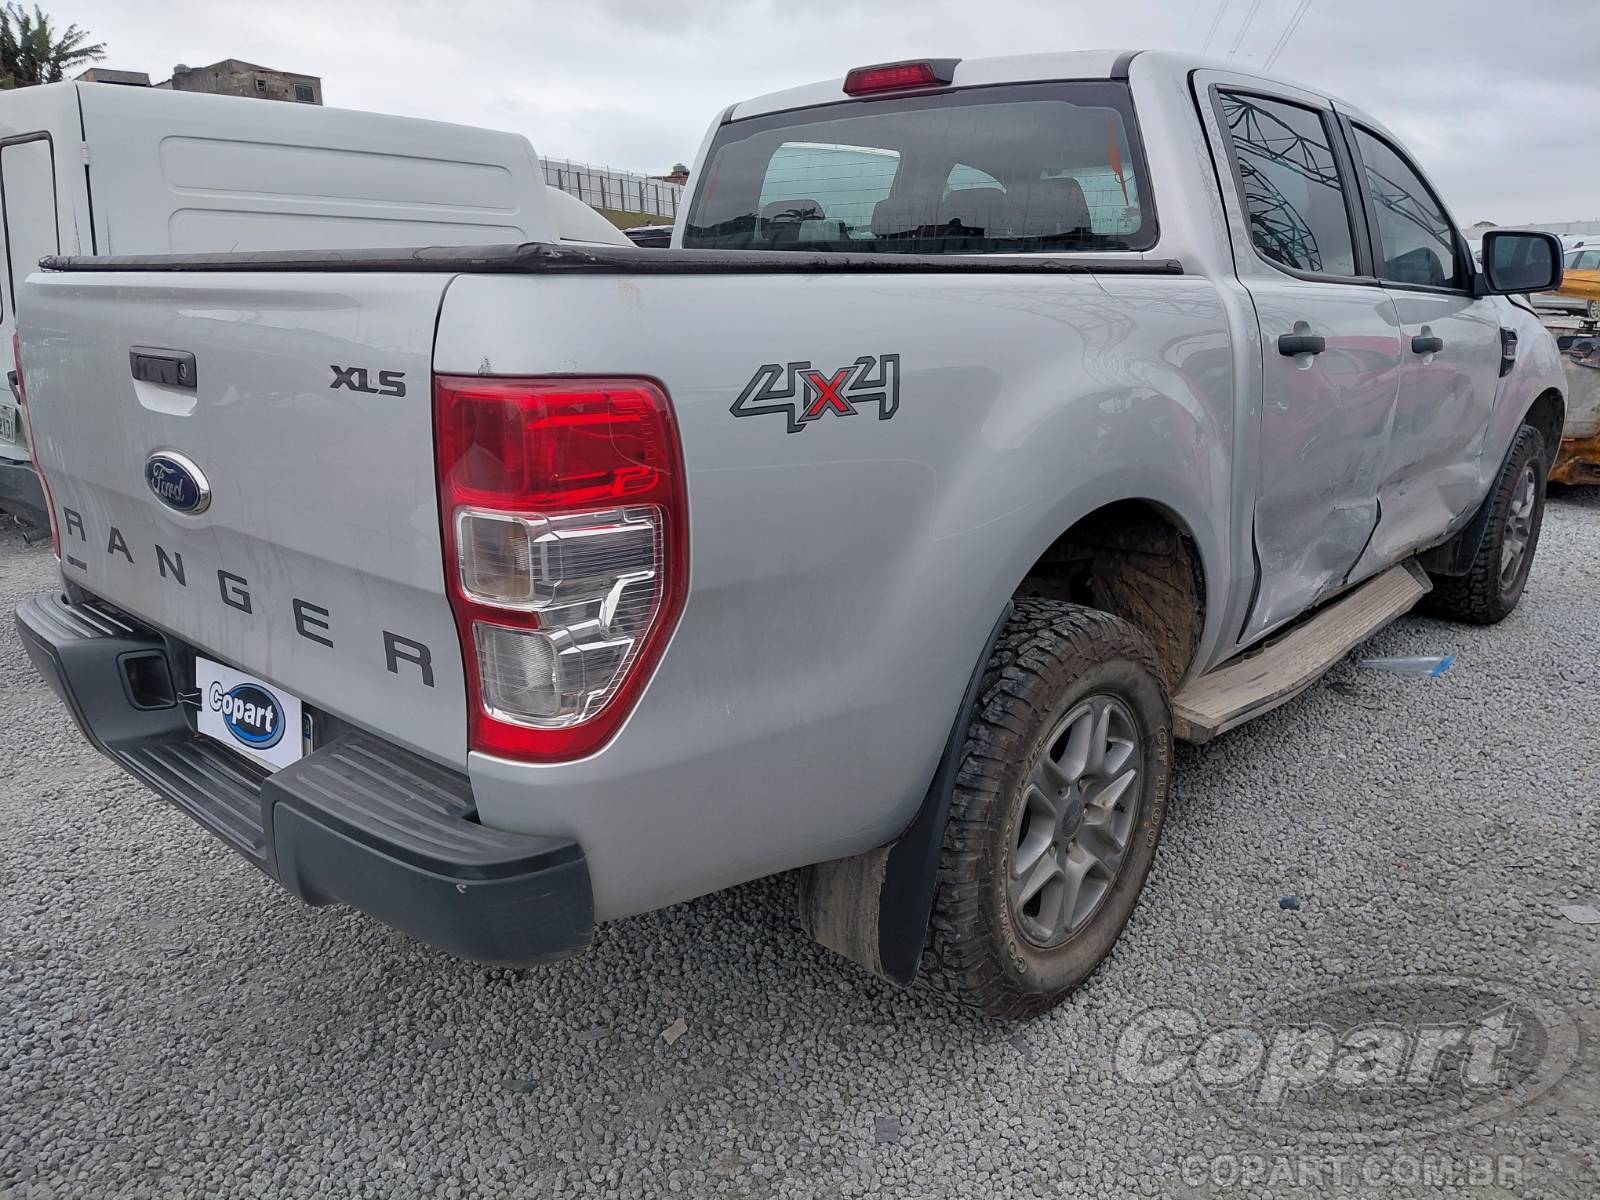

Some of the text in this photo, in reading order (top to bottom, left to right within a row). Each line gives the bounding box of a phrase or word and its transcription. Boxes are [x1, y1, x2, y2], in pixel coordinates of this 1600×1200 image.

[330, 365, 406, 397] XLS
[151, 462, 185, 502] Ford
[63, 506, 435, 688] RANGER
[209, 681, 274, 734] Copart
